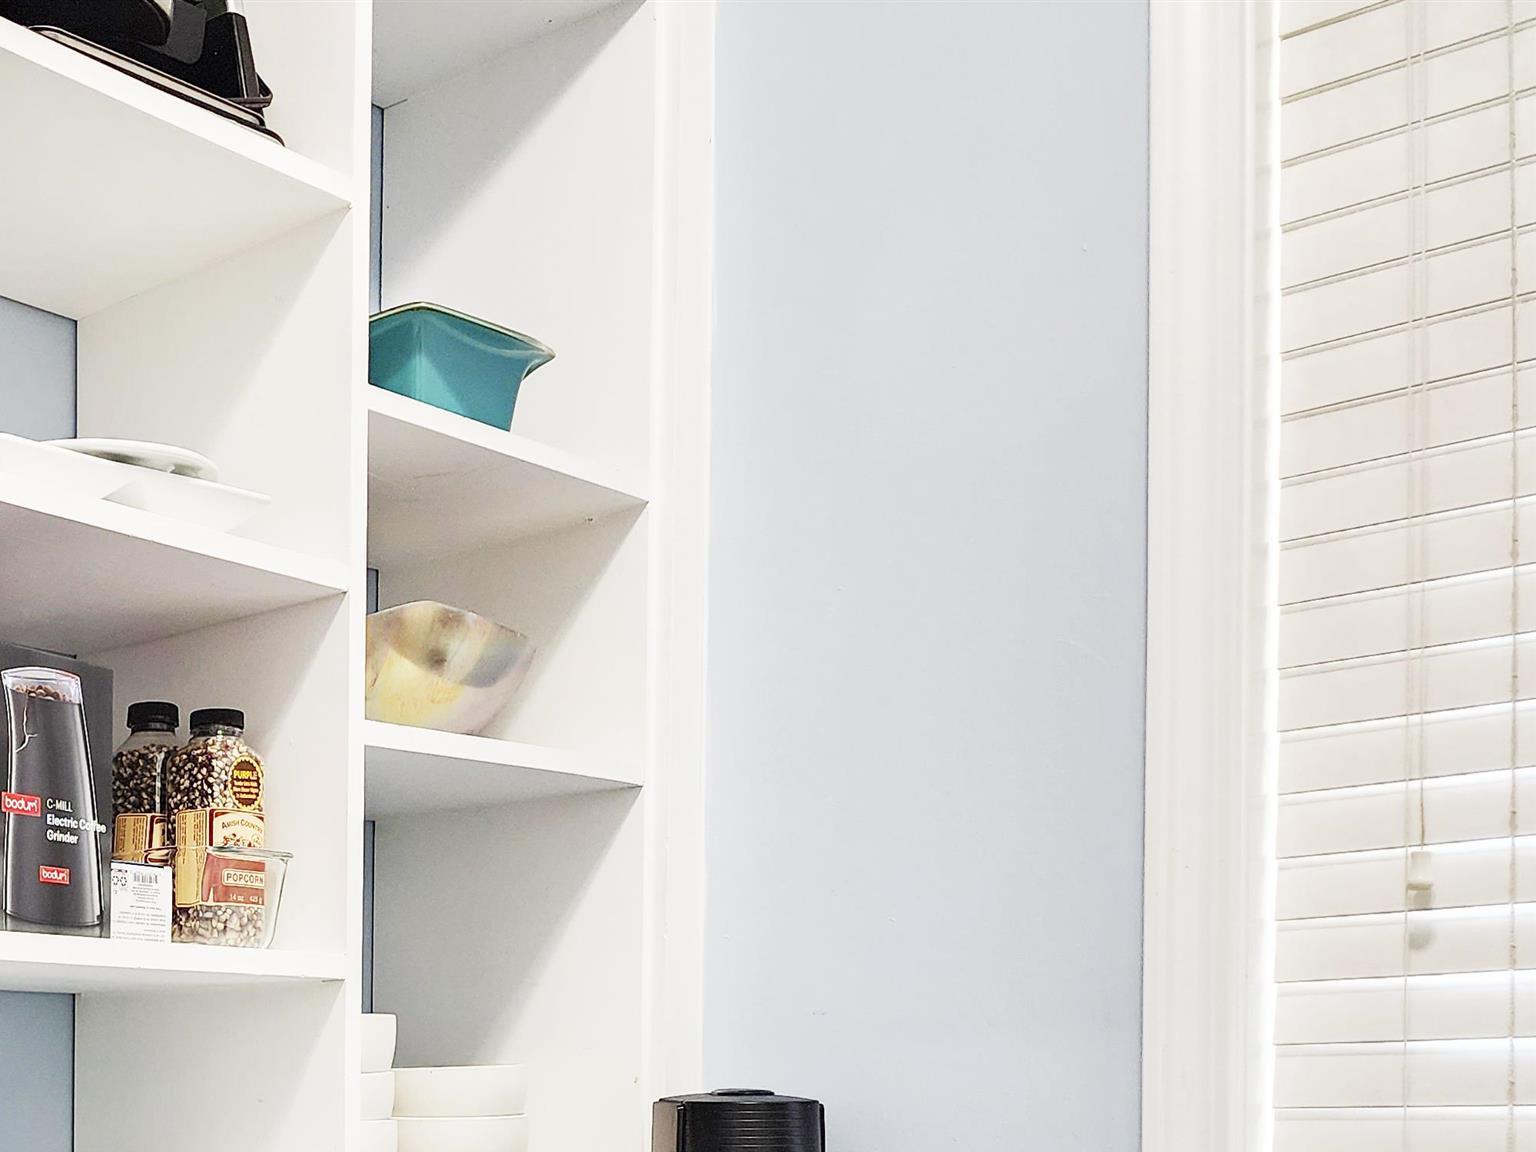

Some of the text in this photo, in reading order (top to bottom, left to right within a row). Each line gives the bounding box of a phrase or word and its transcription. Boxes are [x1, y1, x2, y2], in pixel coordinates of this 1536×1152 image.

[5, 795, 39, 813] bodum
[46, 798, 73, 813] C-MILL
[46, 813, 107, 833] Electric Coffee
[46, 828, 80, 844] Grinder
[41, 869, 68, 882] bodum
[226, 871, 264, 884] POPCORN
